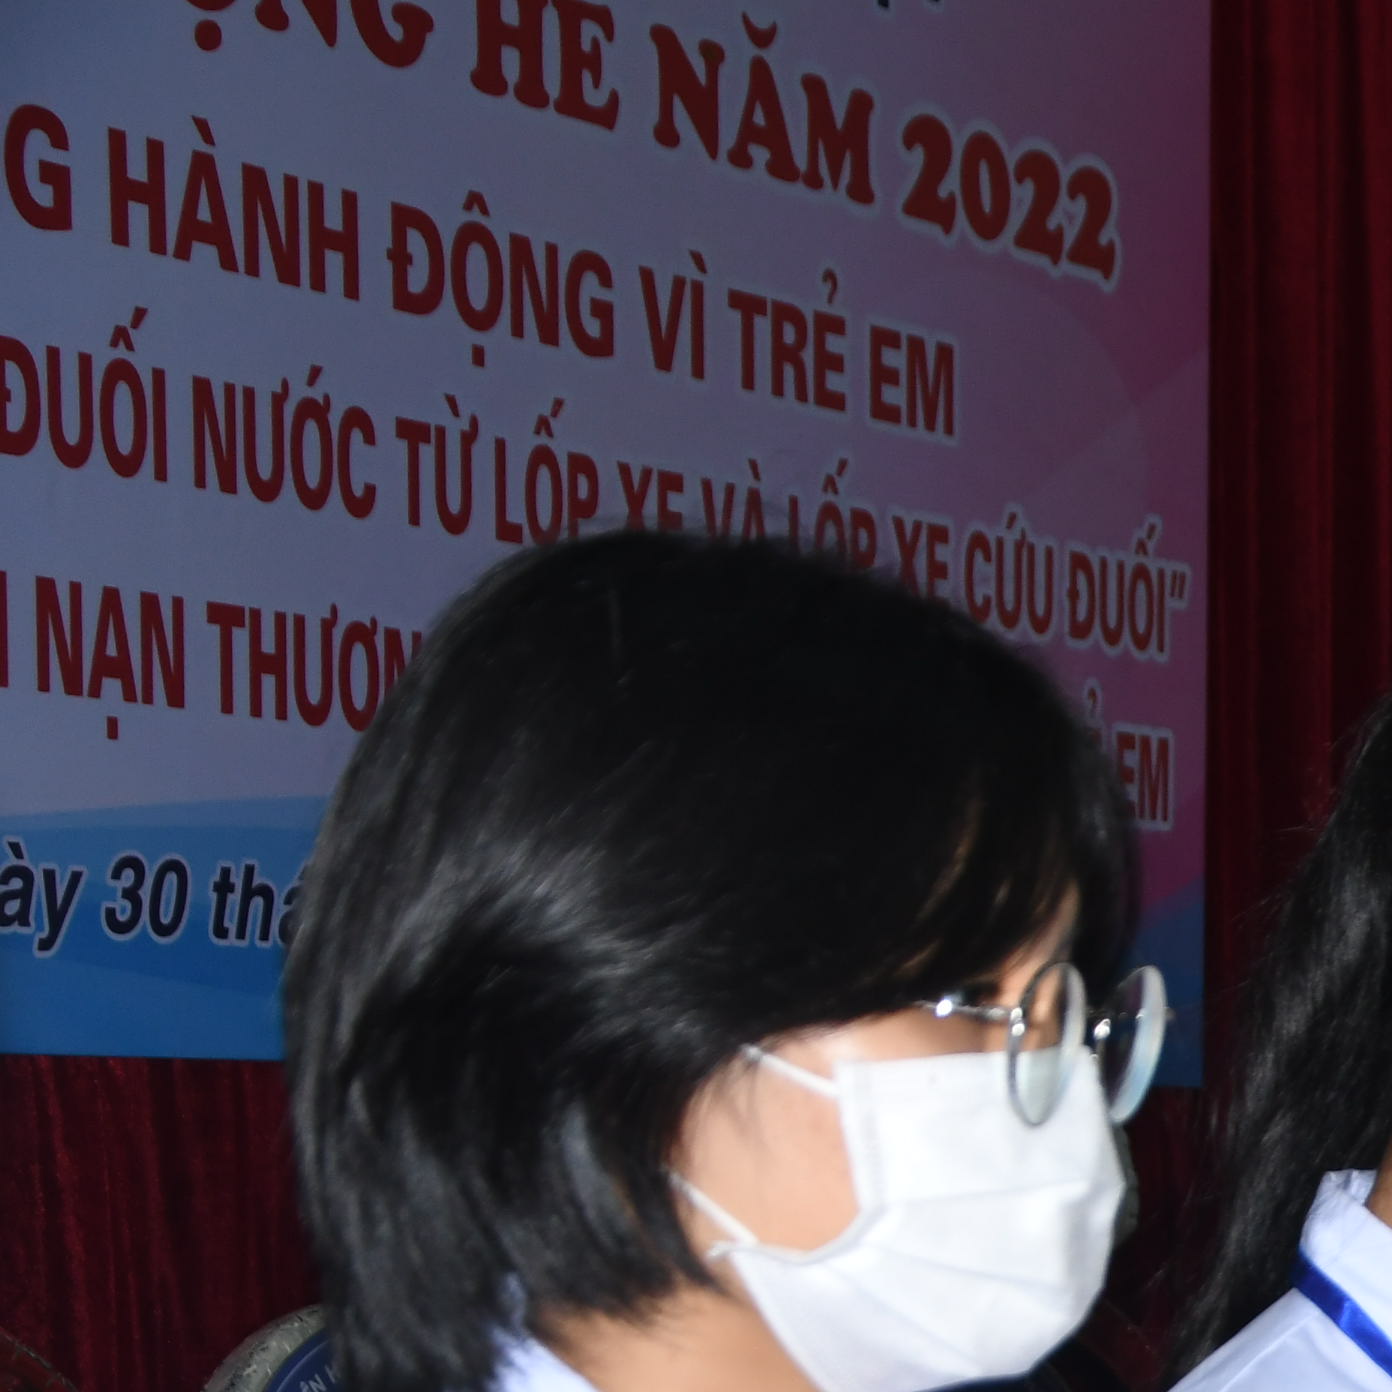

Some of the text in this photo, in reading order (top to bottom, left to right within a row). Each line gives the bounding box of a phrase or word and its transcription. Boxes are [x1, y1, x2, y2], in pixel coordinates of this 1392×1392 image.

[107, 115, 361, 301] HÀNH
[386, 190, 616, 367] ĐỘNG
[638, 249, 707, 380] VÌ
[727, 268, 848, 413] TRẺ
[869, 324, 956, 437] EM
[650, 12, 876, 206] NĂM
[902, 114, 1117, 282] 2022
[0, 306, 168, 483] ĐUỐI
[191, 364, 378, 520] NƯỚC
[395, 393, 480, 537] TỪ
[494, 398, 600, 545] LỐP
[964, 513, 1056, 637] CỨU
[1067, 523, 1187, 655] ĐUỐI"
[35, 575, 187, 741] NẠN
[105, 855, 189, 938] 30
